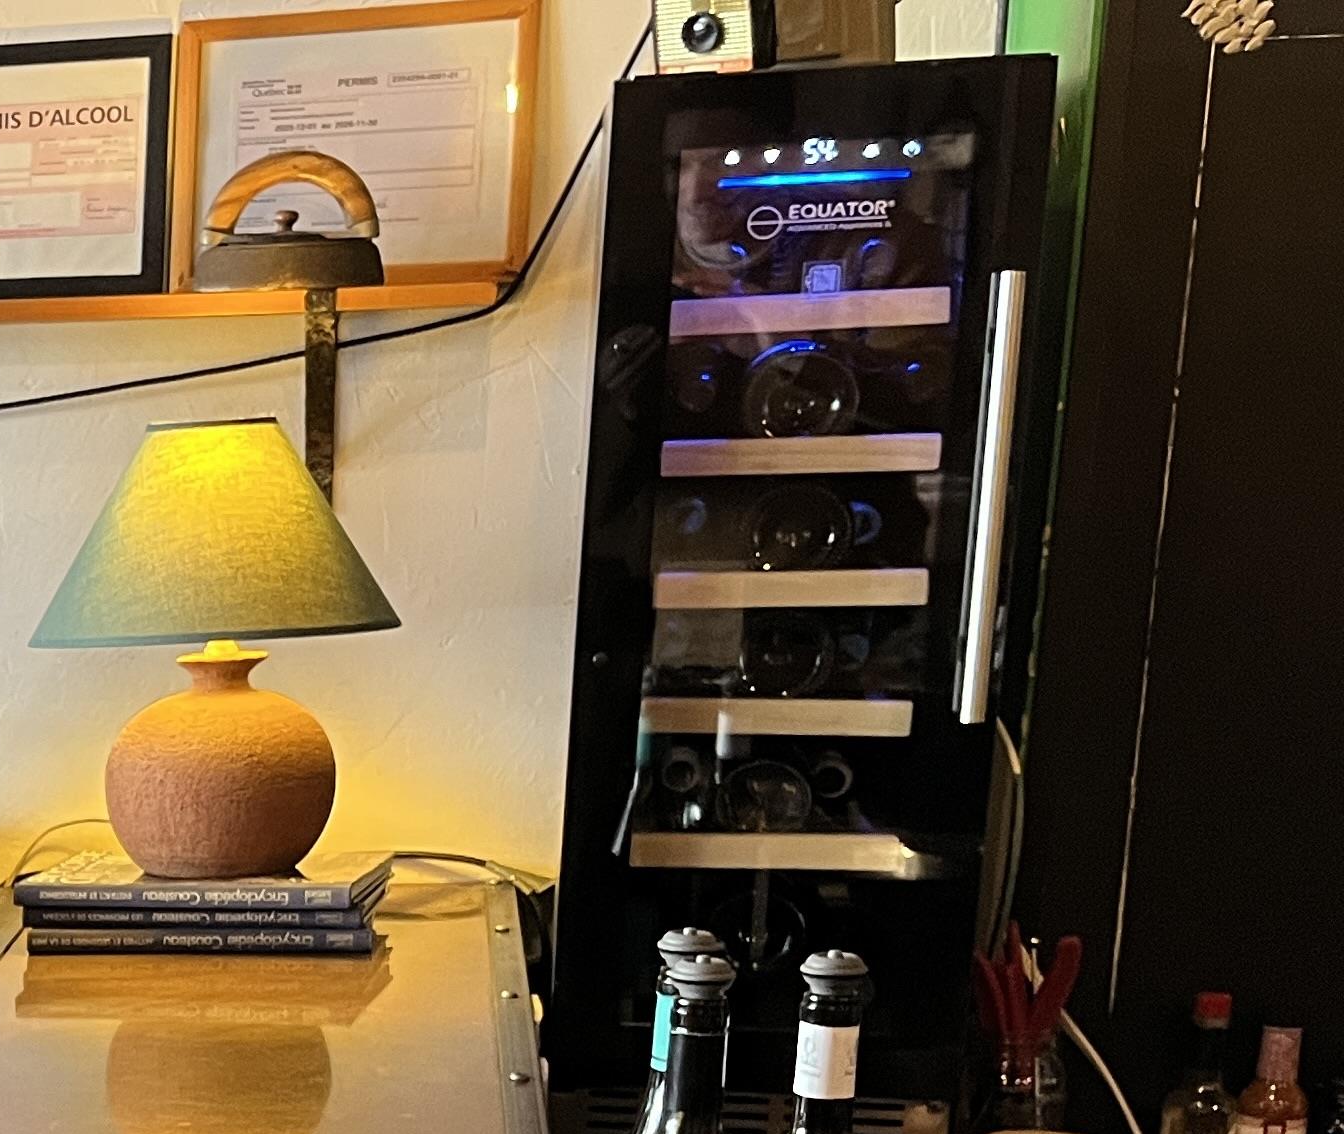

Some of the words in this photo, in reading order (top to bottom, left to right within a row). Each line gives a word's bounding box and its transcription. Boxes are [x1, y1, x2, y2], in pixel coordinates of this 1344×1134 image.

[337, 76, 379, 88] PERMIS
[28, 105, 134, 128] D'ALCOOL
[142, 889, 201, 906] Cousteau
